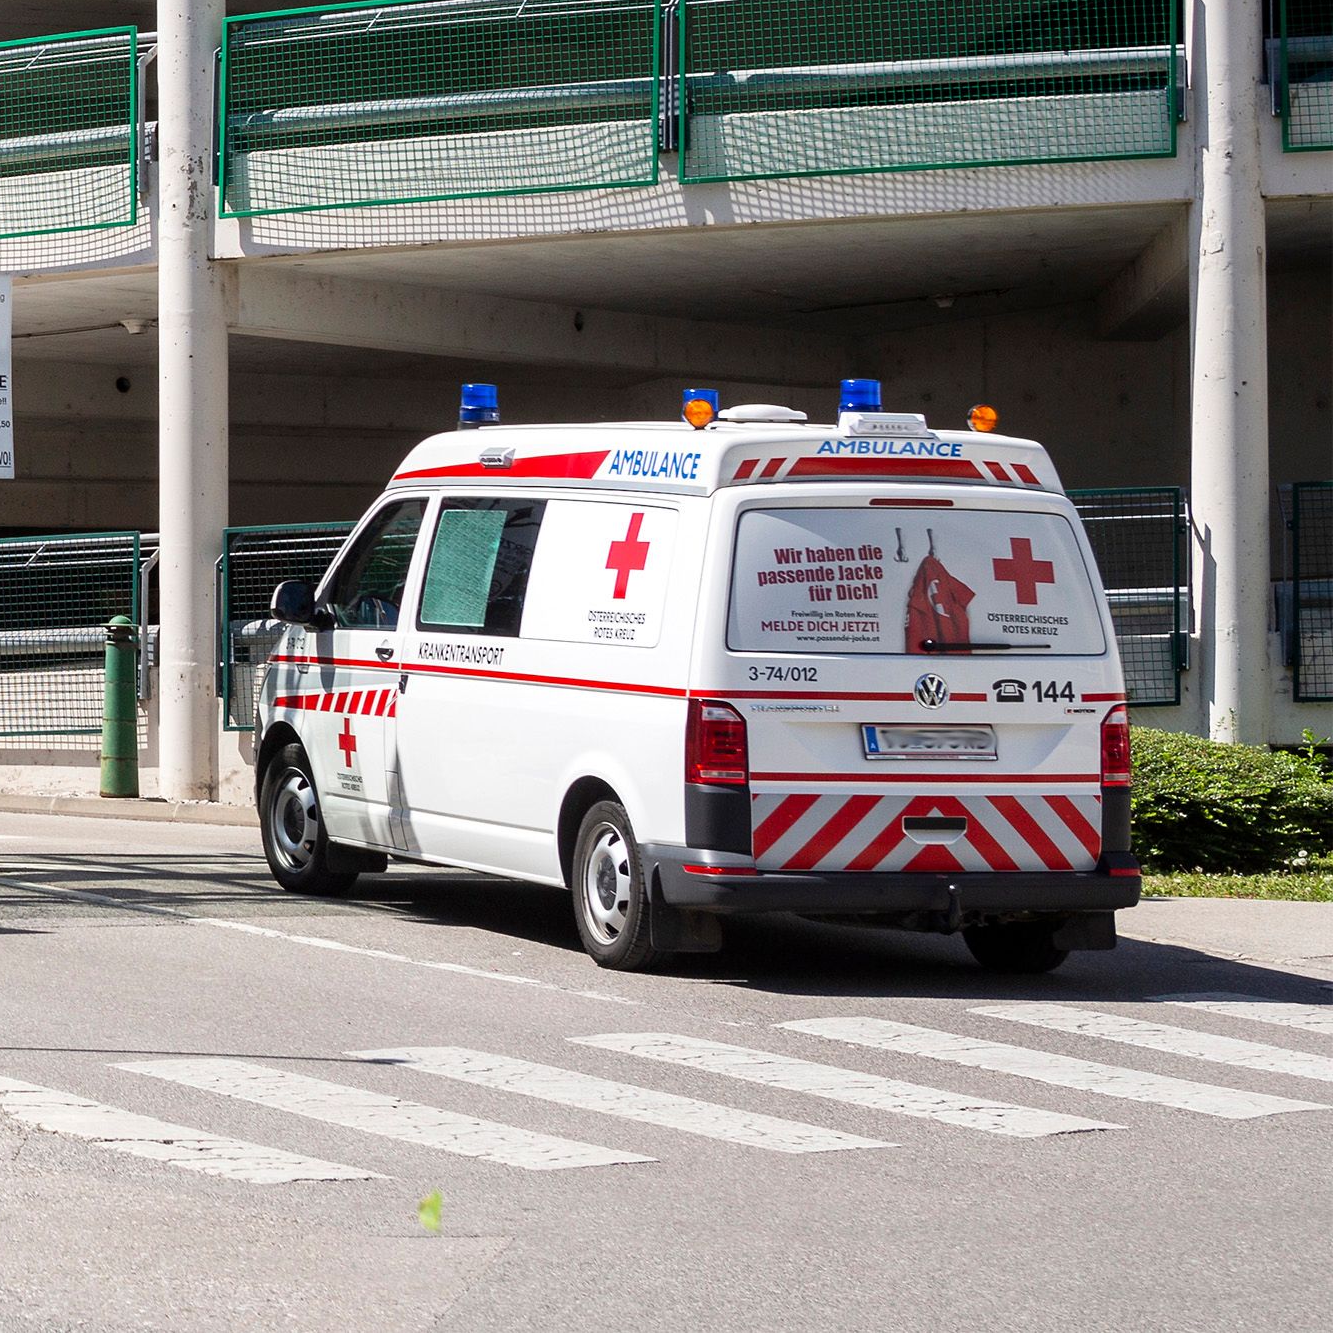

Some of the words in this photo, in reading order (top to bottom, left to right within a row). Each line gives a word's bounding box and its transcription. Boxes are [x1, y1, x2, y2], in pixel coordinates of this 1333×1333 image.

[817, 440, 963, 458] AMBULANCE
[609, 449, 702, 480] AMBULANCE
[774, 547, 802, 565] Wir
[805, 546, 855, 563] haben
[858, 544, 884, 561] die
[757, 566, 835, 586] passende
[838, 564, 884, 581] Jacke
[808, 585, 832, 602] für
[836, 583, 879, 601] Dich!
[791, 610, 823, 619] Freiwillig
[987, 612, 1069, 625] ÖSTERREICHISCHES
[594, 626, 614, 639] ROTES
[615, 628, 636, 640] KREUZ
[761, 621, 805, 632] MELDE
[807, 621, 839, 632] DICH
[841, 621, 880, 632] JETZT!
[1002, 625, 1029, 634] ROTES
[1031, 626, 1059, 636] KREUZ
[796, 635, 880, 643] www.passende-jacke.at
[418, 642, 505, 666] KRANKENTRANSPORT
[748, 666, 818, 683] 3-74/012
[1032, 680, 1075, 703] 144
